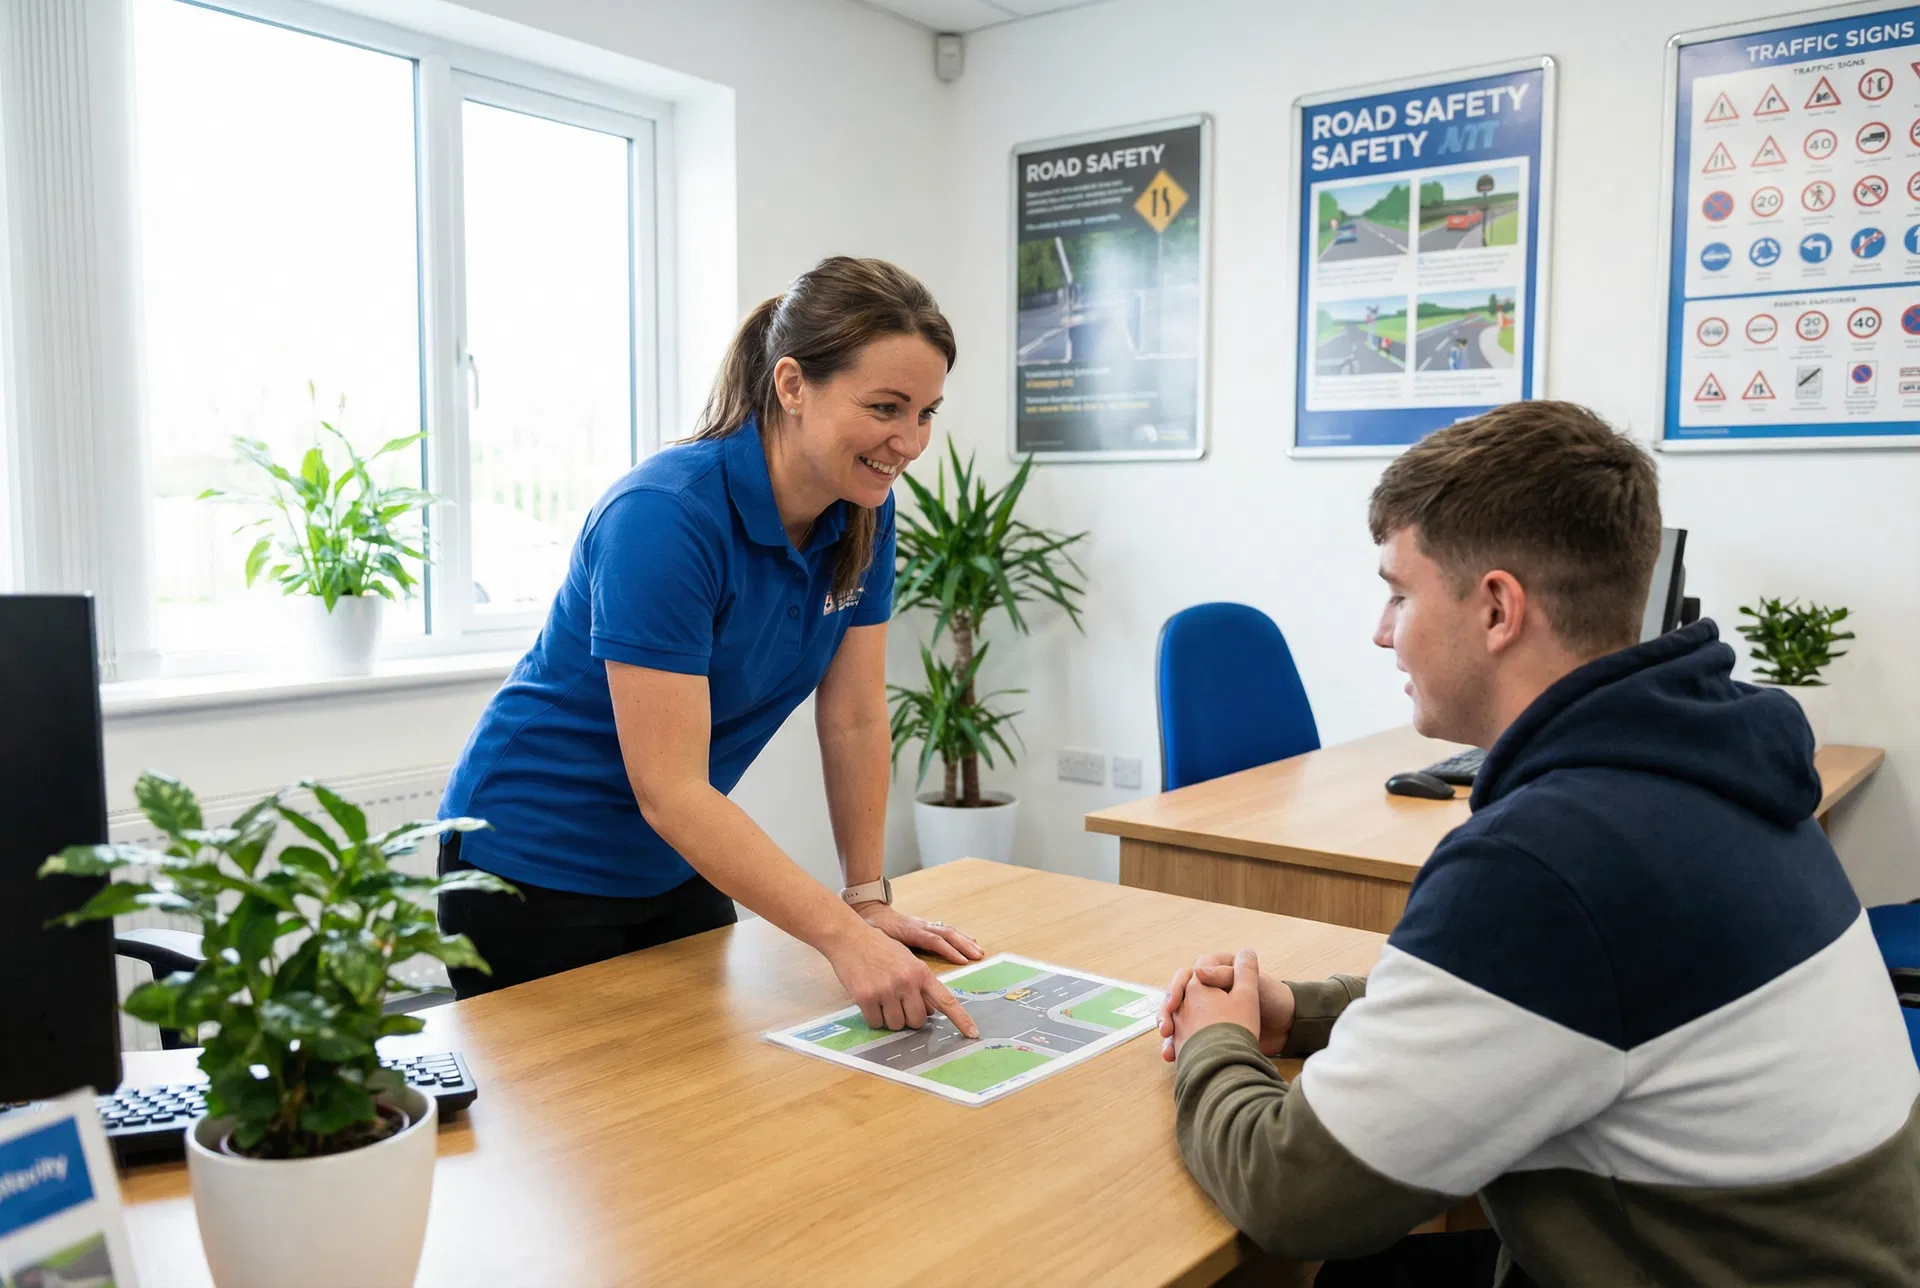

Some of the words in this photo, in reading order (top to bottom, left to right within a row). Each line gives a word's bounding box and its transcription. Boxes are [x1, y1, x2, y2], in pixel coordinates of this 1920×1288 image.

[1747, 33, 1838, 63] TRAFFIC
[1845, 21, 1915, 47] SIGNS
[1312, 105, 1397, 141] ROAD
[1405, 83, 1529, 126] SAFETY
[1026, 157, 1081, 183] ROAD
[1086, 143, 1165, 174] SAFETY
[1311, 130, 1429, 171] SAFETY
[1809, 138, 1832, 151] 40
[1757, 194, 1779, 208] 20
[1853, 316, 1876, 329] 40
